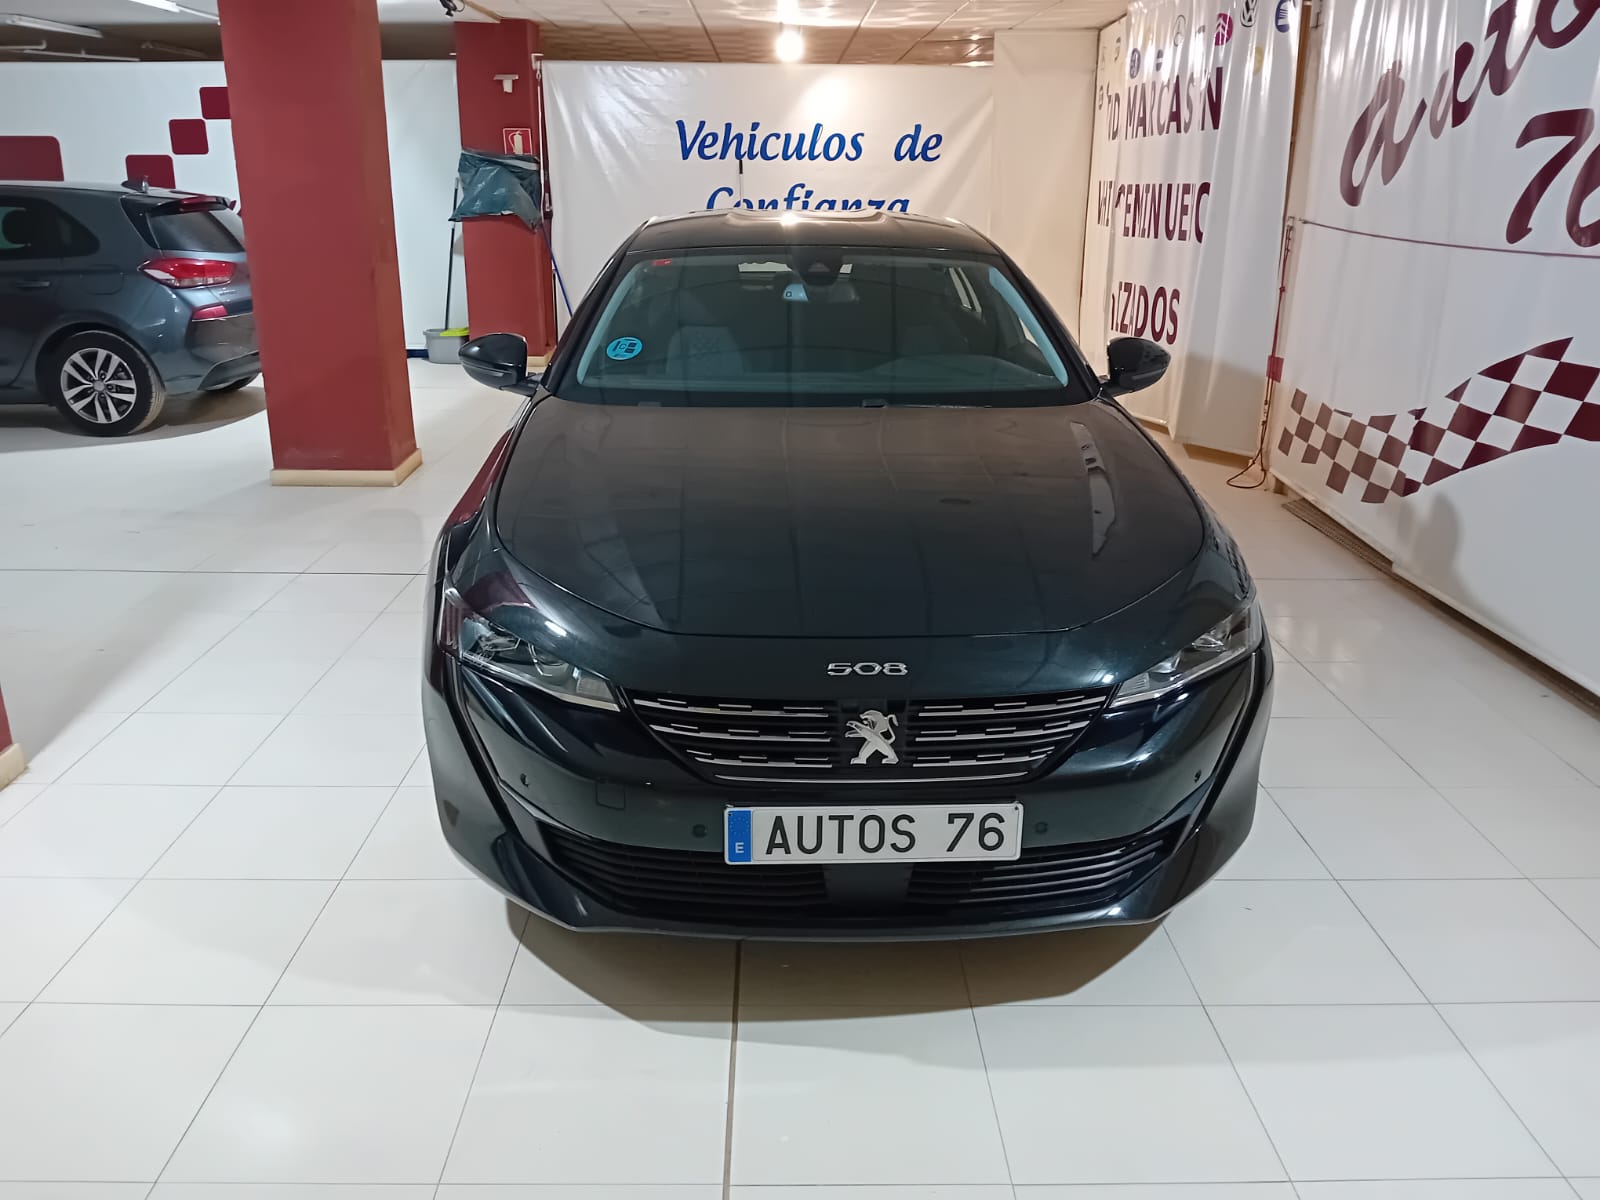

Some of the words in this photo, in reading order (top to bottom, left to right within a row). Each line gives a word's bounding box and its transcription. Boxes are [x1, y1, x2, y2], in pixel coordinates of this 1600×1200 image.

[1125, 71, 1194, 140] MARCAS
[894, 123, 943, 162] de
[1111, 281, 1180, 345] IZADOS
[827, 662, 908, 676] 508
[735, 842, 745, 854] E
[765, 814, 917, 855] AUTOS
[945, 812, 1006, 852] 76
